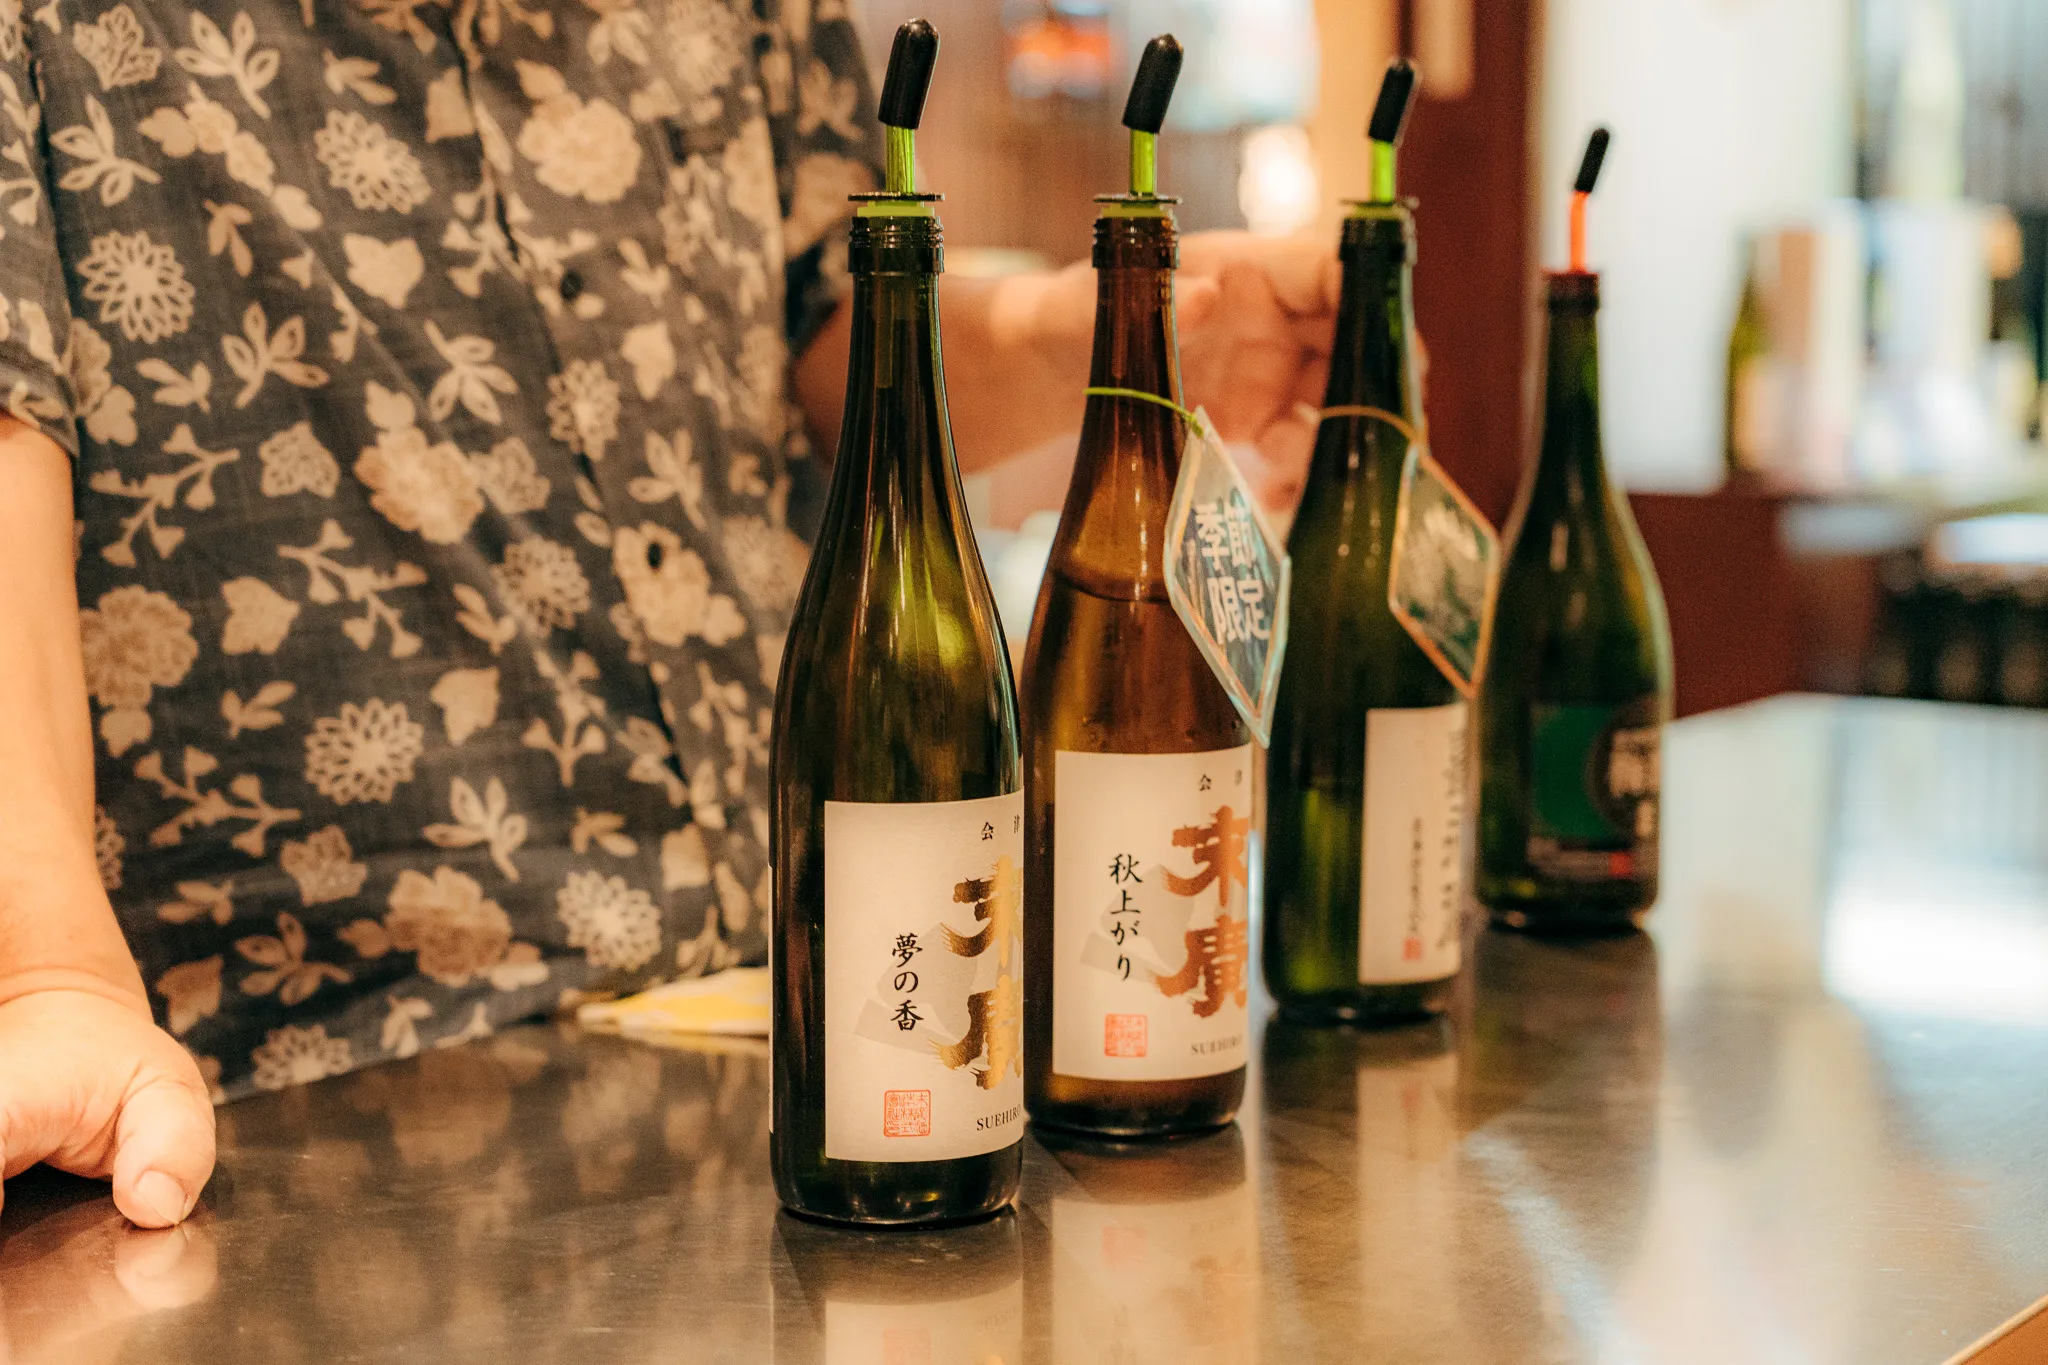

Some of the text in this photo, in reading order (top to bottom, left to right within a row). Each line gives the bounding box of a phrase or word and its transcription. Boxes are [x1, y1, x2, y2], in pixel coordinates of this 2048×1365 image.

[1206, 574, 1273, 645] 限定
[1108, 853, 1144, 983] 秋上がり
[890, 933, 924, 1032] 夢の香
[976, 1103, 1022, 1132] SUEHIRO
